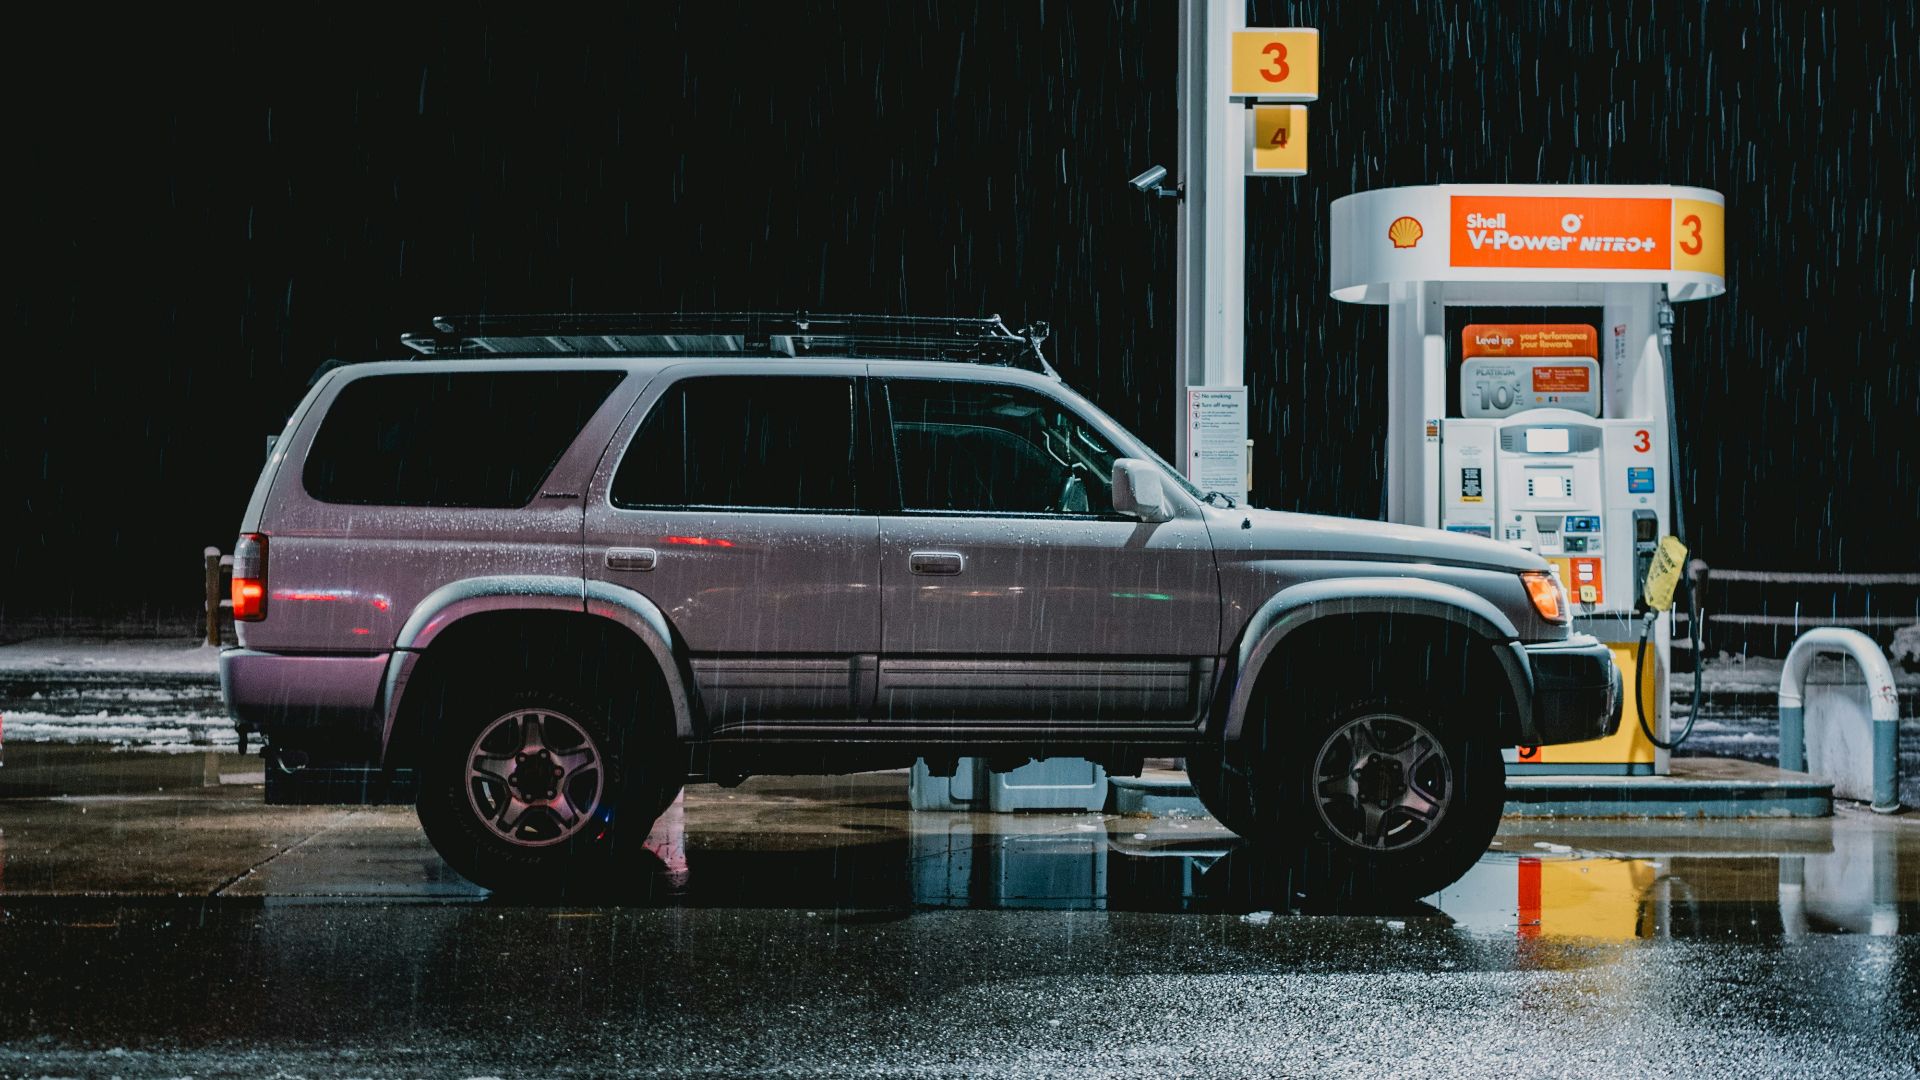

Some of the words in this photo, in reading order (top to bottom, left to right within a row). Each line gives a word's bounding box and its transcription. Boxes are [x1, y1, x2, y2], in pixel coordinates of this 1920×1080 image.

[1260, 42, 1290, 83] 3
[1270, 128, 1288, 149] 4
[1466, 213, 1506, 229] Shell
[1679, 215, 1703, 256] 3
[1475, 335, 1500, 345] Level
[1501, 337, 1515, 347] up
[1519, 334, 1538, 342] your
[1539, 332, 1588, 340] Performance
[1520, 341, 1538, 350] your
[1539, 340, 1573, 348] Rewards
[1633, 429, 1651, 453] 3
